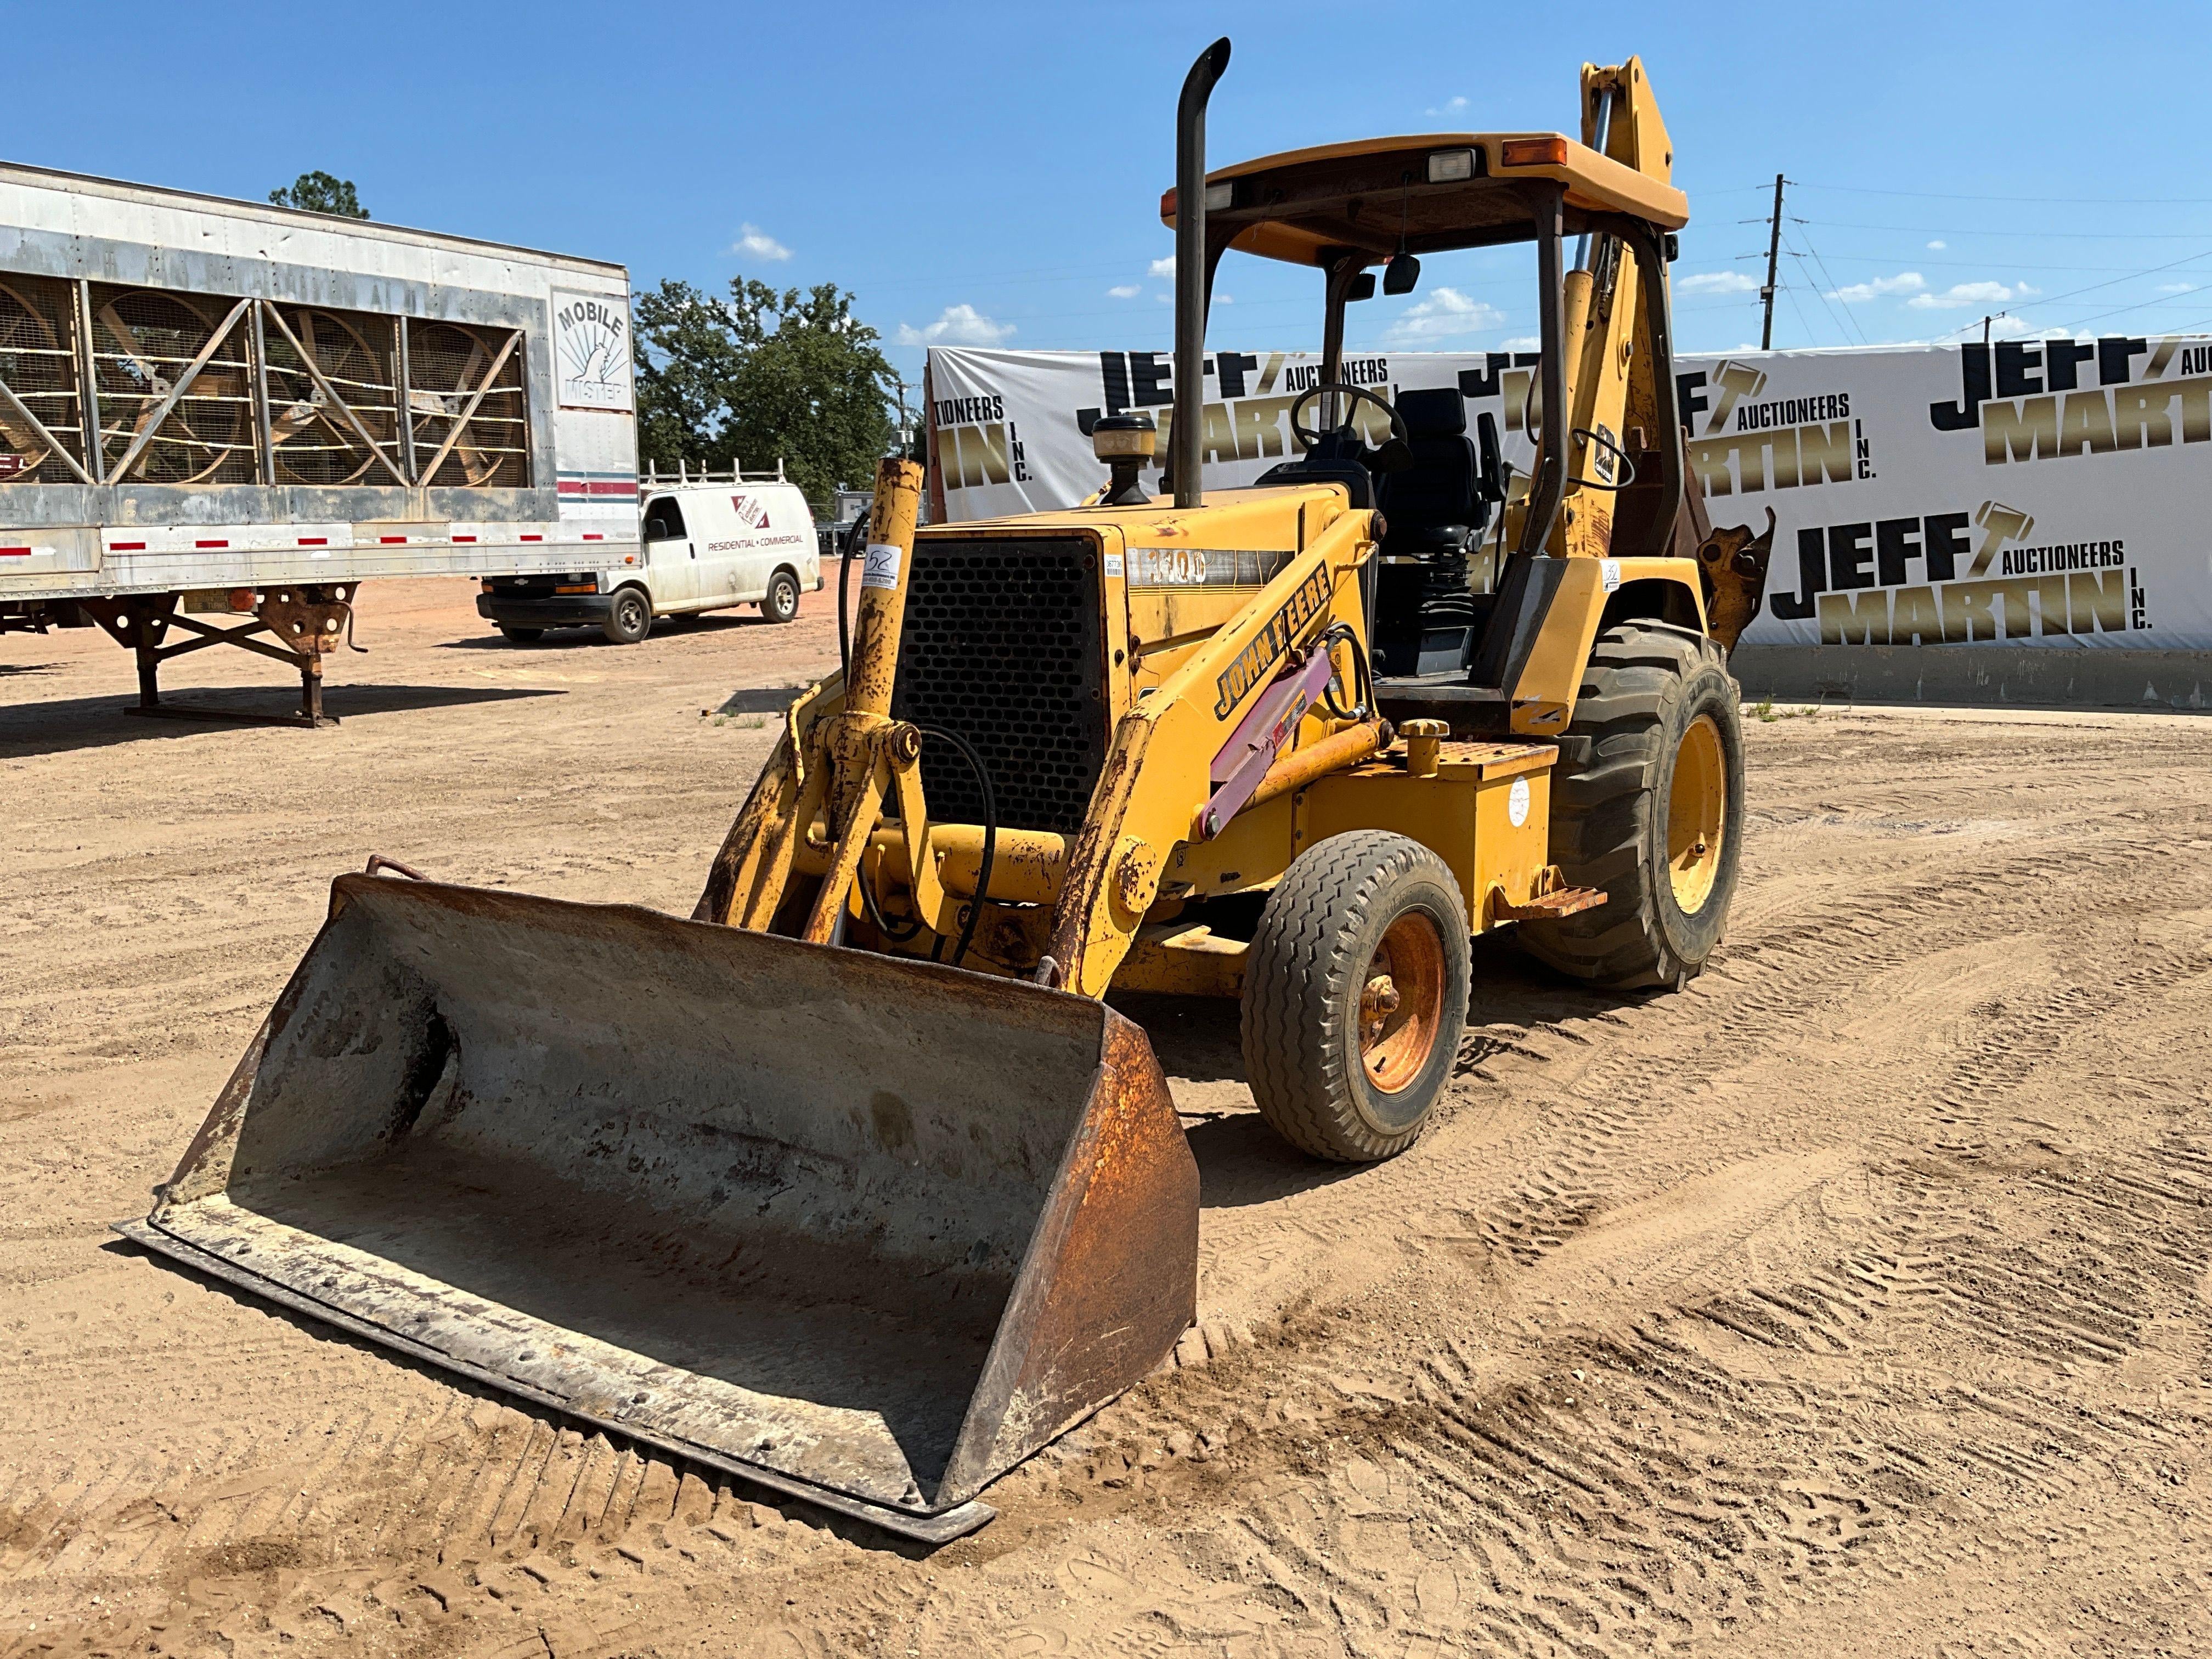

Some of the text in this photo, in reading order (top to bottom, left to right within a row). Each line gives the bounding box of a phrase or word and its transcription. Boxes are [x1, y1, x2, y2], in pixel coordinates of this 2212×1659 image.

[558, 302, 623, 337] MOBILE
[1286, 358, 1388, 392] AUCTNEERS
[1929, 337, 2148, 431] JEFF
[1076, 352, 1257, 437] JEF
[1737, 393, 1849, 431] AUCTIONEERS
[708, 535, 804, 552] RESIDENTIAL COMMERCIAL
[869, 550, 893, 571] 52
[2002, 540, 2124, 575] AUCTIONEERS
[1769, 512, 1971, 620] JEFF
[1819, 569, 2126, 645] MARTIN
[1218, 630, 1273, 716] JOHN
